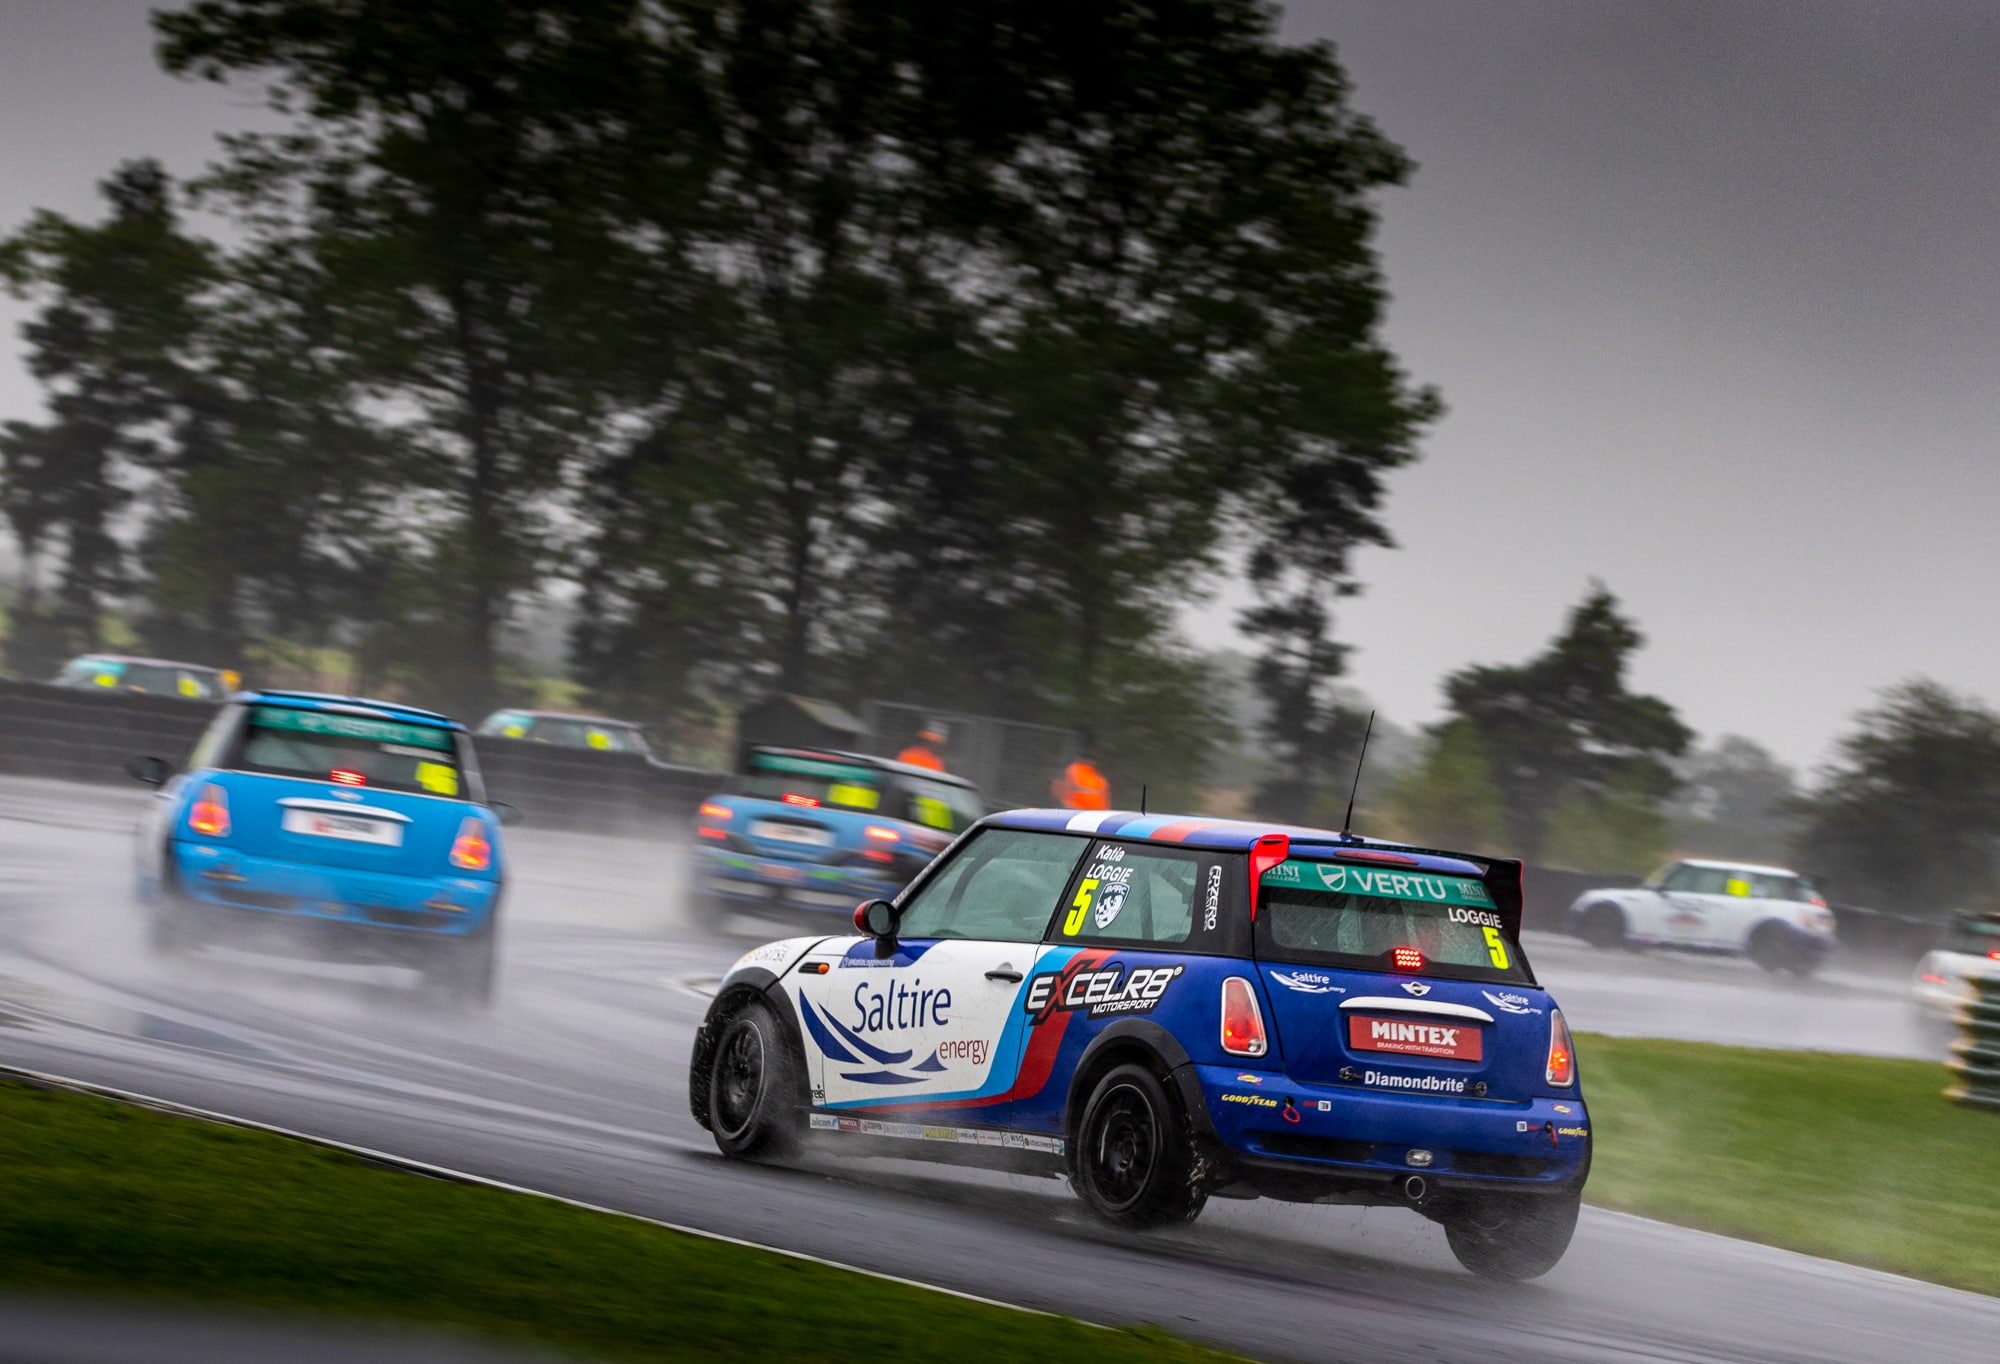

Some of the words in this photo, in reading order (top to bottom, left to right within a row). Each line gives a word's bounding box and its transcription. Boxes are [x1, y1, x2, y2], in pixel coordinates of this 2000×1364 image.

[1096, 844, 1126, 862] Katia
[1086, 863, 1134, 883] LOGGIE
[1352, 869, 1447, 899] VERTU
[1063, 878, 1100, 936] 5
[1447, 907, 1503, 929] LOGGIE
[1482, 926, 1509, 970] 5
[1291, 971, 1330, 984] Saltire
[852, 978, 952, 1033] Saltire
[1092, 999, 1159, 1014] MOTORSPORT
[1371, 1020, 1457, 1047] MINTEX
[939, 1039, 989, 1065] energy
[1364, 1070, 1465, 1092] Diamondbrite
[1221, 1094, 1278, 1107] GOODYEAR
